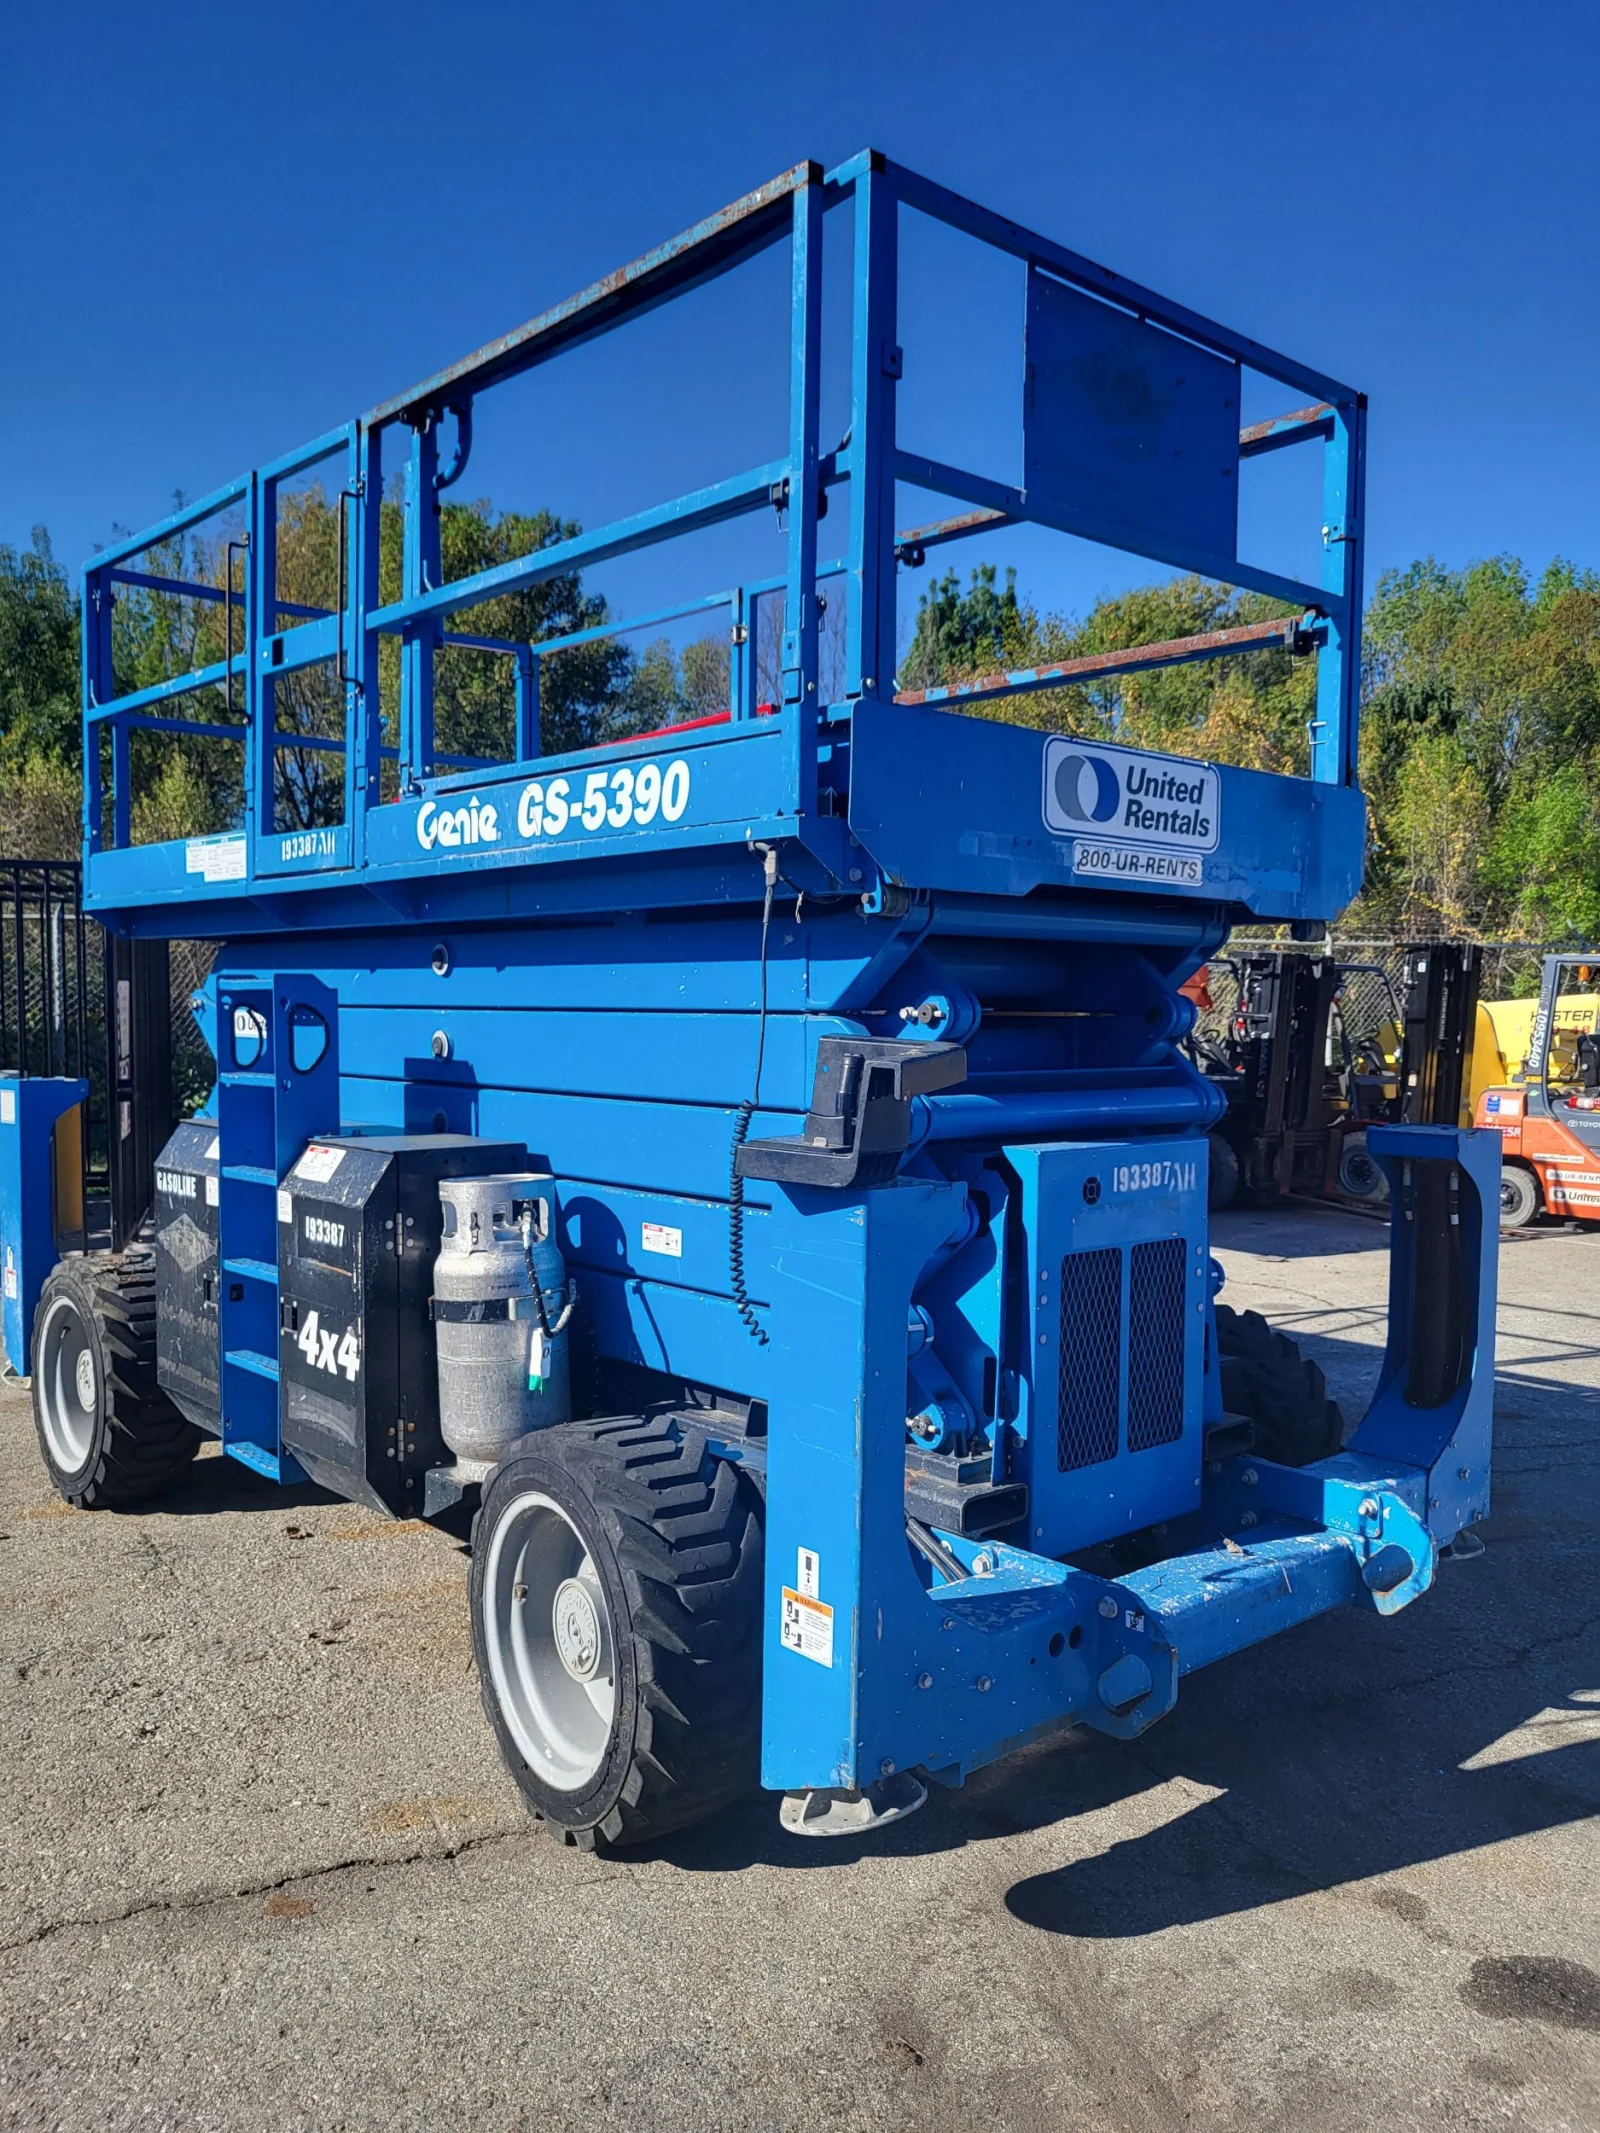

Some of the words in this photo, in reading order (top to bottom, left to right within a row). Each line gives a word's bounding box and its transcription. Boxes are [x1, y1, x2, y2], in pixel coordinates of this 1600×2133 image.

[1126, 765, 1205, 804] United
[417, 795, 498, 850] Genie
[517, 759, 690, 839] GS-5390
[1124, 799, 1210, 837] Rentals
[1079, 849, 1198, 880] 800-UR-RENTS
[1530, 1010, 1594, 1021] HSTER
[1528, 1007, 1549, 1068] 10953440
[1579, 1120, 1600, 1128] TOYO
[156, 1170, 197, 1198] GASOLINE
[305, 1215, 345, 1248] 193387
[298, 1310, 360, 1381] 4x4
